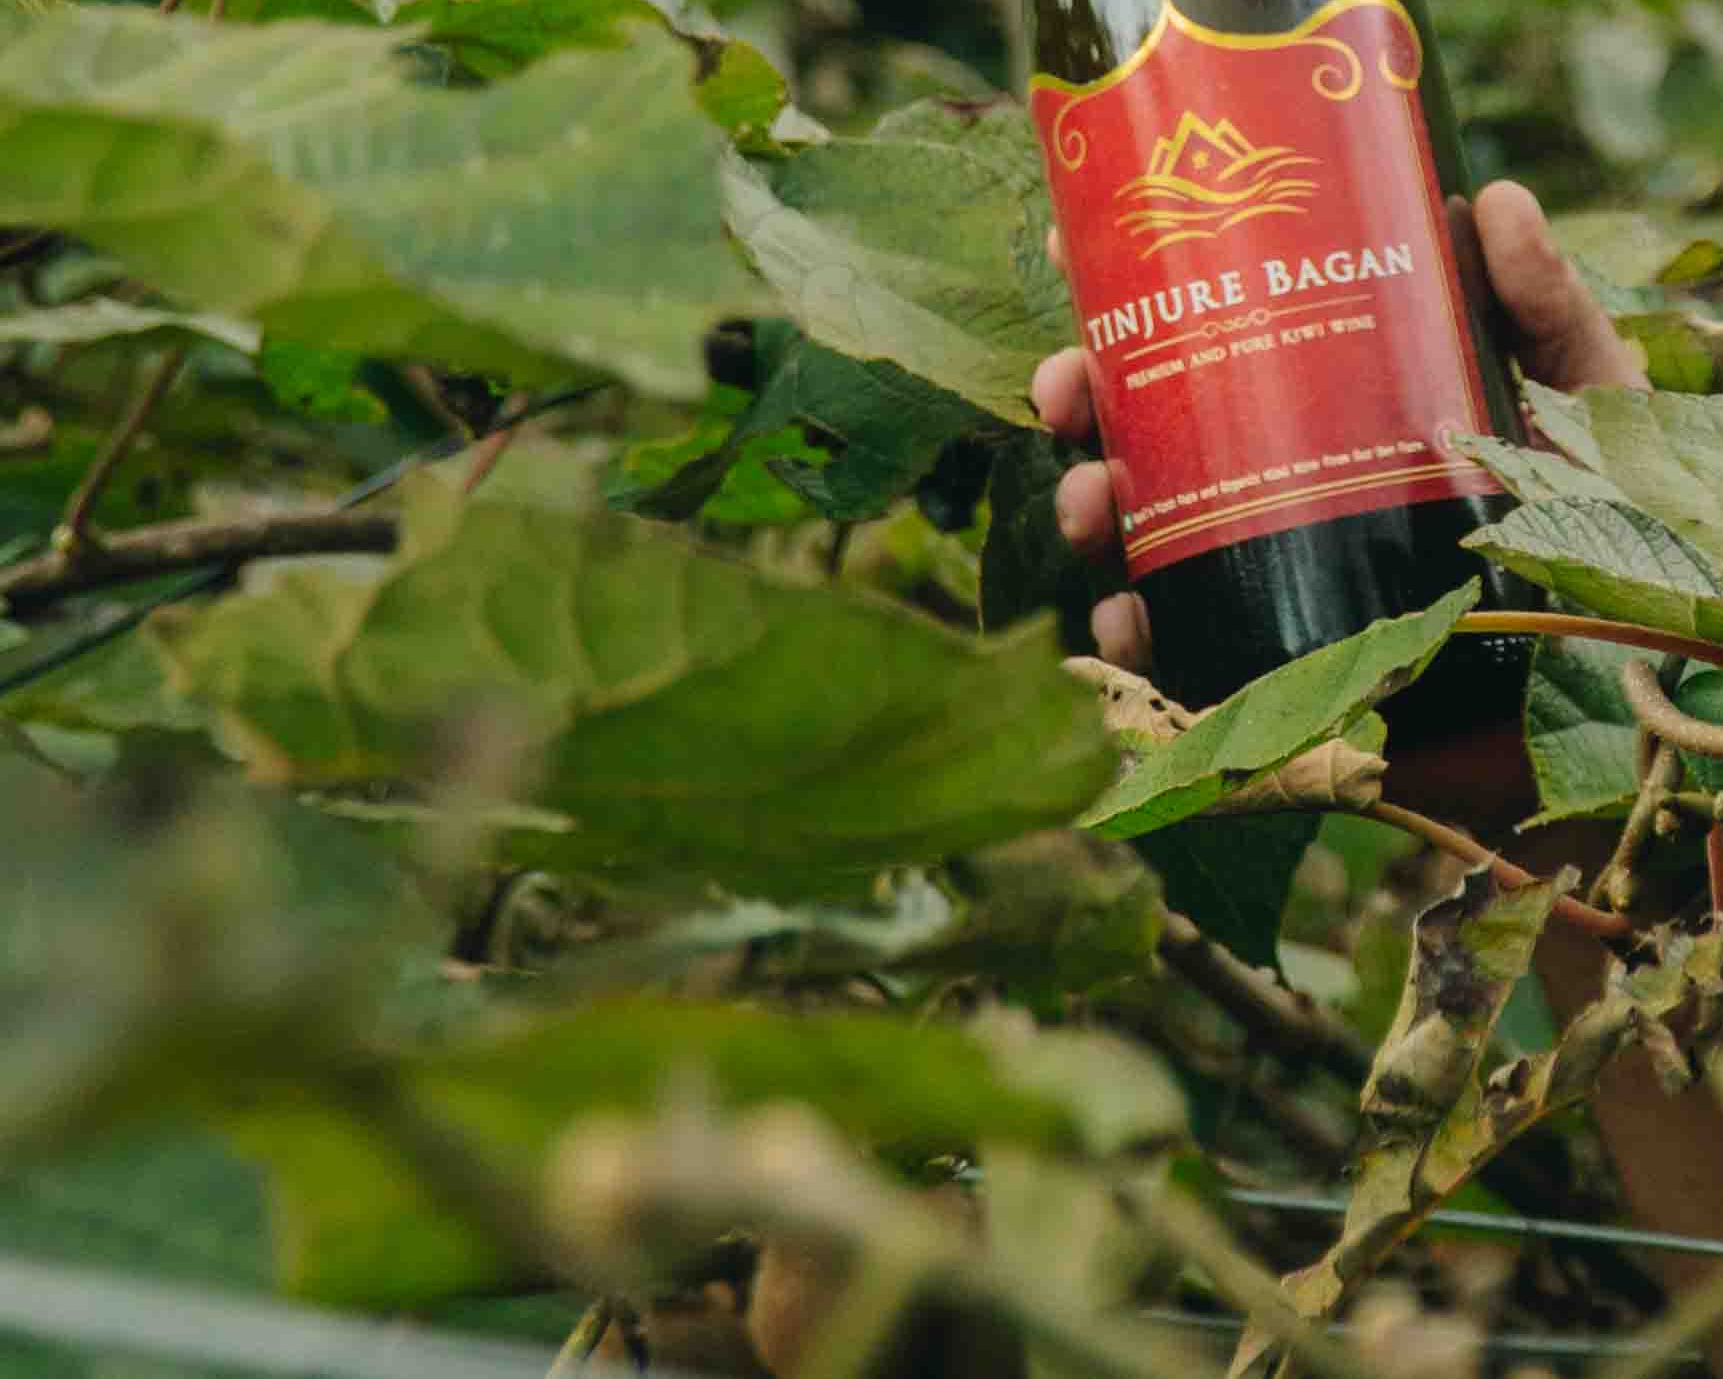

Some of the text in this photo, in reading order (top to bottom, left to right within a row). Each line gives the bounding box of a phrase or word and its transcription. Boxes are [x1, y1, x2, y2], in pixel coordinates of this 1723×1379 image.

[1088, 270, 1246, 351] TINJURE
[1189, 344, 1227, 368] AND
[1329, 313, 1378, 334] WINE
